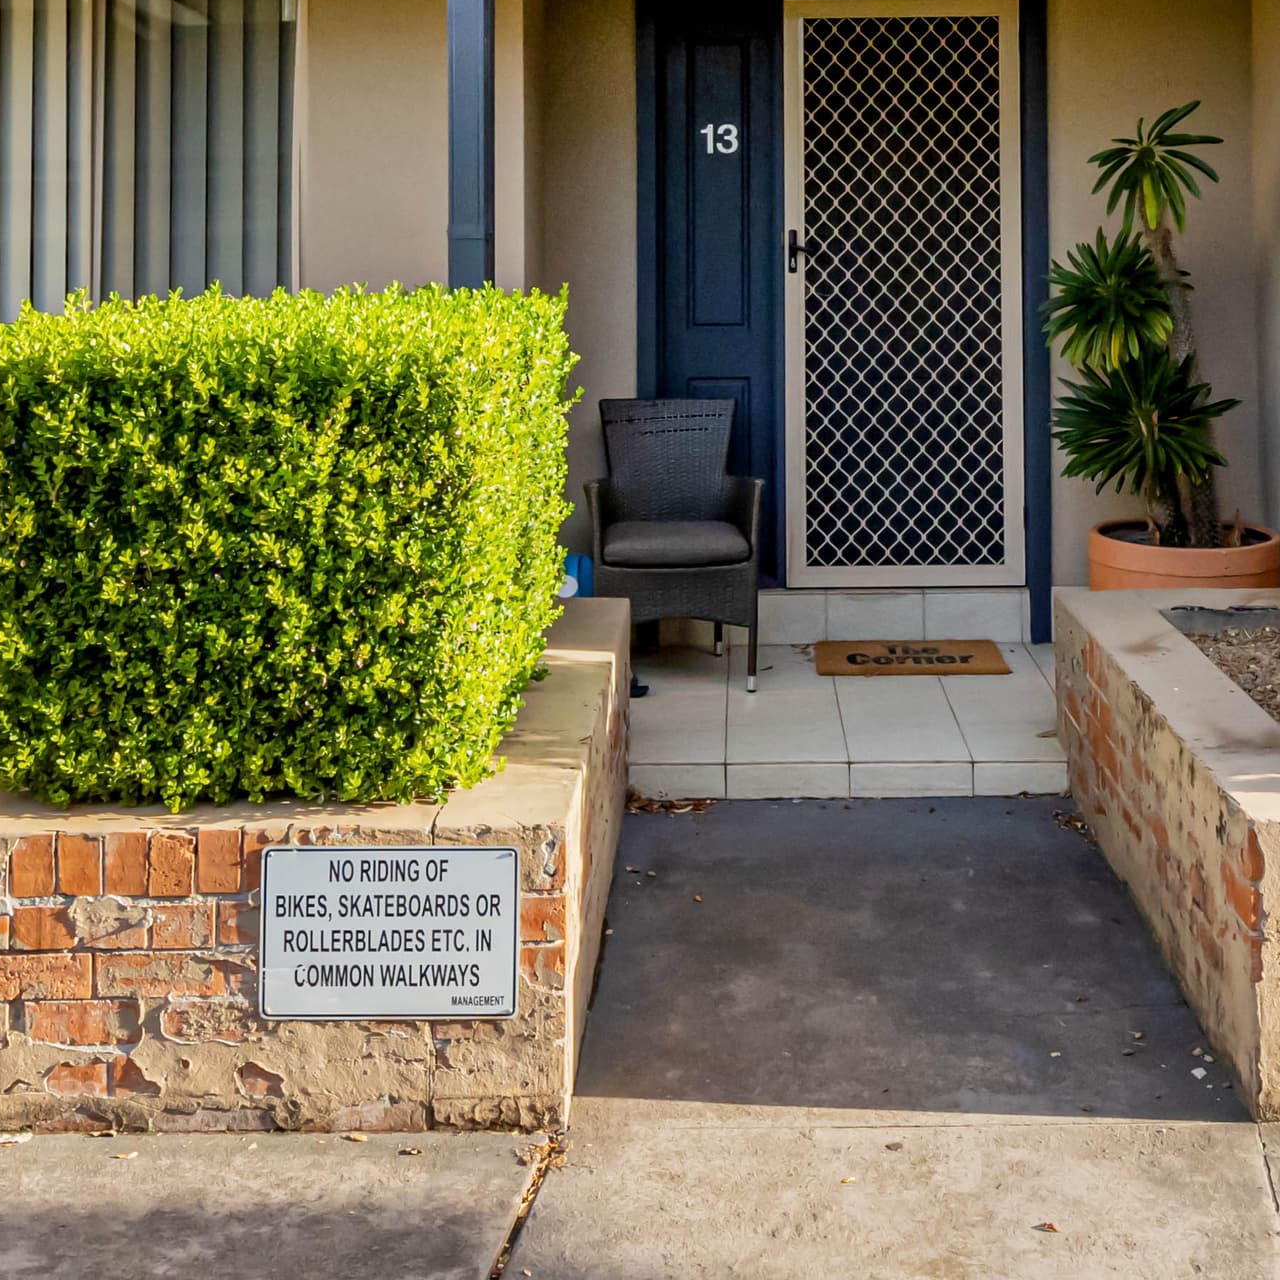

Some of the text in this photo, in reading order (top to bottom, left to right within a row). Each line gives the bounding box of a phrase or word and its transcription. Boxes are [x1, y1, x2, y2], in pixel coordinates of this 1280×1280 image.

[699, 123, 739, 154] 13
[846, 653, 975, 666] Corner
[329, 859, 449, 882] NO RIDING OF
[275, 894, 501, 921] BIKES, SKATEBOARDS OR
[283, 929, 492, 953] ROLLERBLADES ETC. IN
[294, 964, 480, 987] COMMON WALKWAYS
[451, 996, 505, 1006] MANAGEMENT
